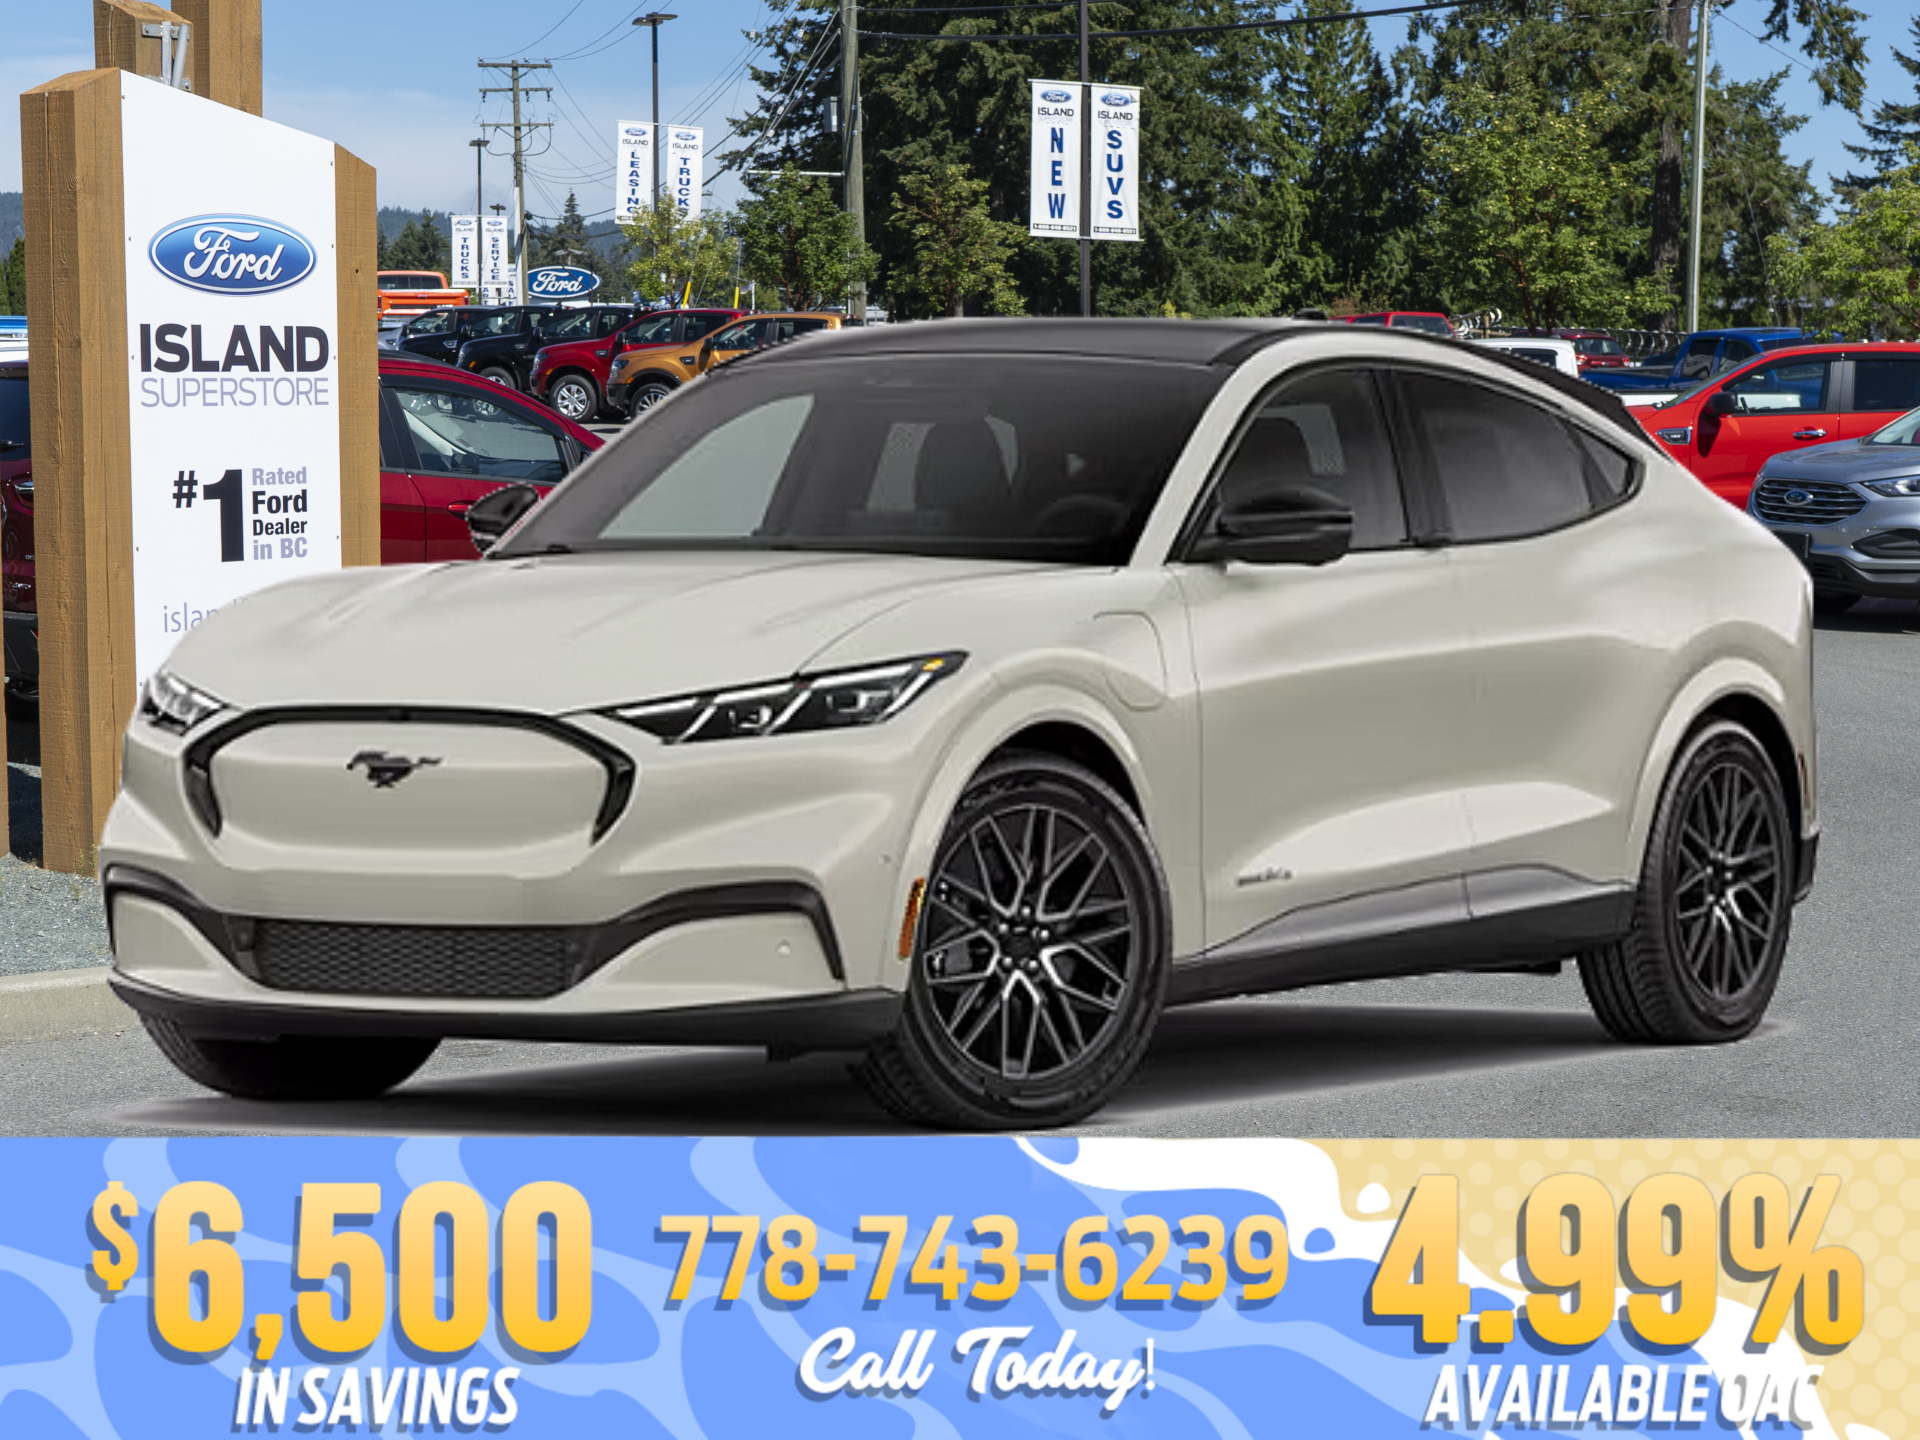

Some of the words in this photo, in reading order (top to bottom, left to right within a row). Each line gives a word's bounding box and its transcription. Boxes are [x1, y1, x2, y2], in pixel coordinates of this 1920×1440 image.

[1045, 92, 1066, 101] Ford
[1105, 96, 1125, 105] Ford
[1037, 107, 1074, 117] ISLAND
[1098, 110, 1133, 120] ISLAND
[622, 138, 648, 146] ISLAND
[627, 151, 640, 214] LEASING
[678, 157, 690, 217] TRUCKS
[1048, 127, 1066, 219] NEW
[1106, 130, 1124, 219] SUVS
[183, 226, 284, 282] Ford
[460, 237, 470, 279] TRUCKS
[491, 237, 500, 280] SERVICE
[532, 270, 584, 293] Ford
[139, 323, 329, 373] ISLAND
[140, 376, 329, 408] SUPERSTORE
[252, 466, 307, 486] Rated
[172, 469, 244, 562] #1
[252, 489, 308, 514] Ford
[252, 518, 308, 536] Dealer
[253, 540, 273, 560] in
[280, 537, 308, 559] BC
